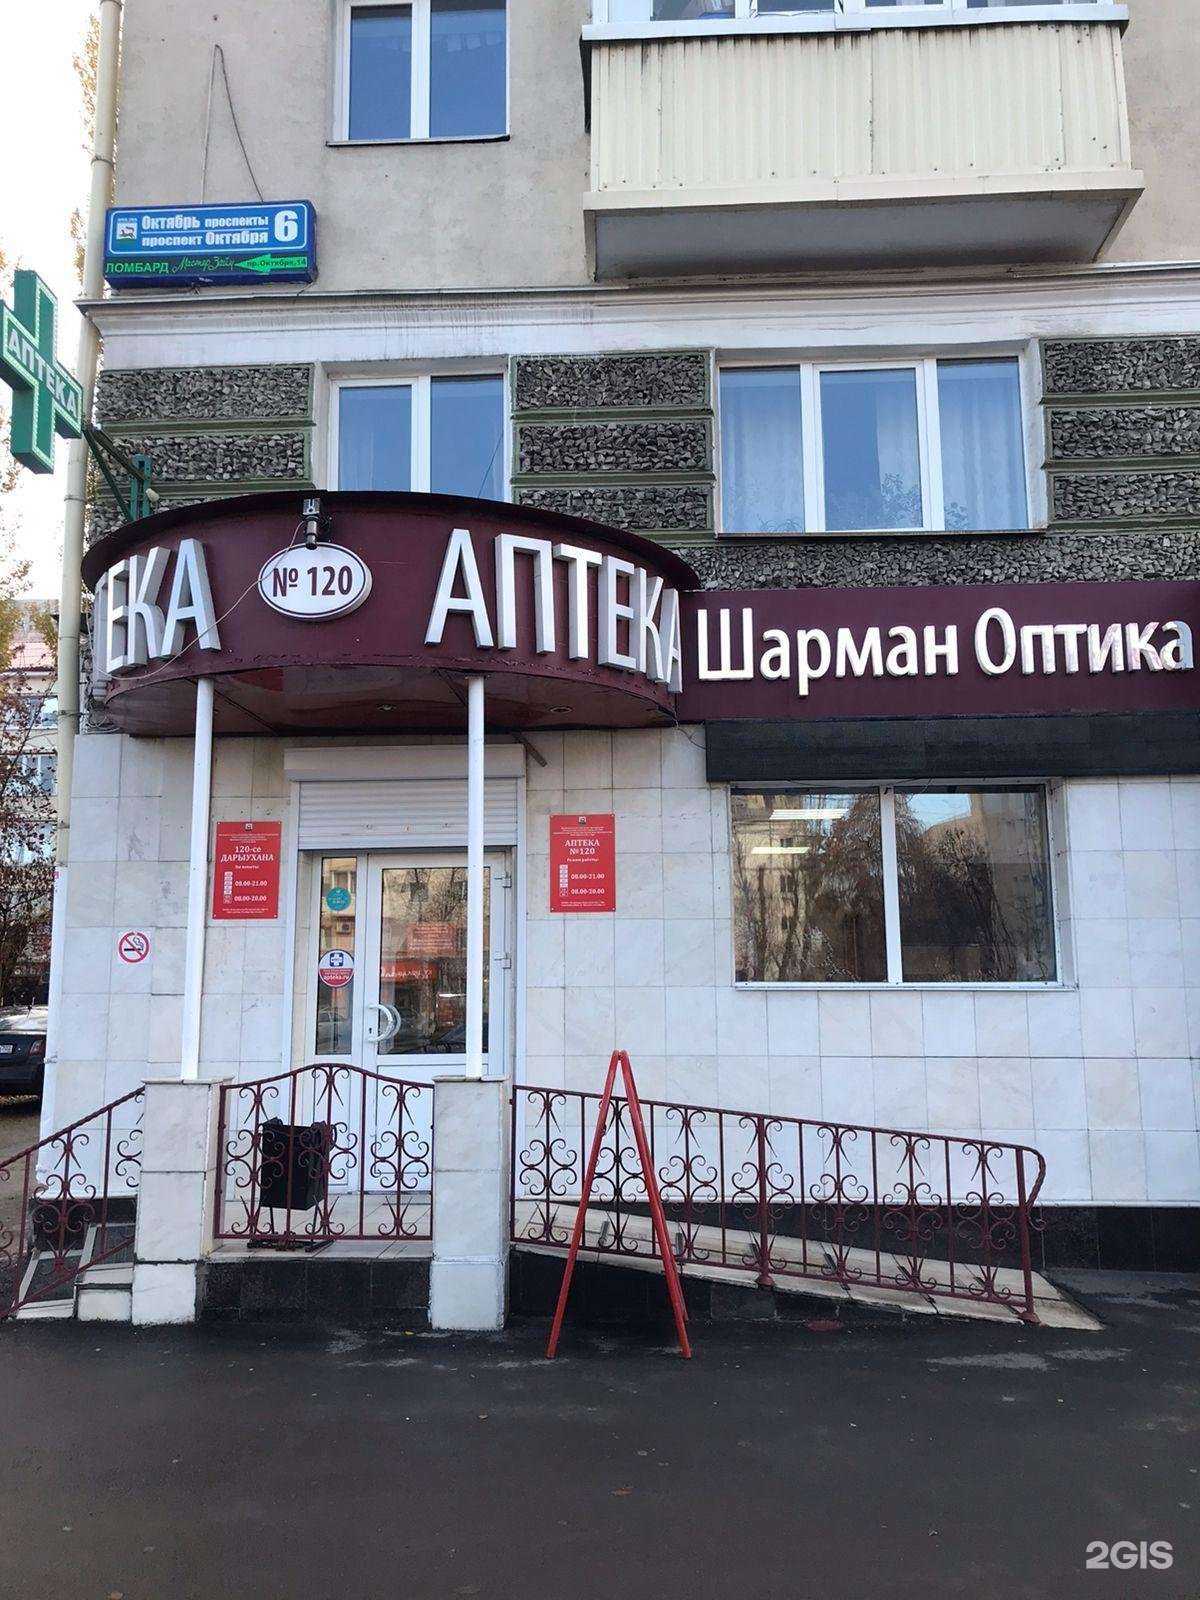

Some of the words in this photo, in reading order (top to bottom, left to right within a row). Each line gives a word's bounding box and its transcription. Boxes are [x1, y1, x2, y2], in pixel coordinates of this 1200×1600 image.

[141, 235, 203, 247] проспект
[205, 230, 269, 245] Октября
[142, 214, 201, 230] Октябрь
[204, 215, 269, 229] проспекты
[274, 209, 299, 243] 6
[105, 262, 170, 275] ЛОМБАРД
[8, 328, 78, 418] АПТЕКА
[307, 564, 353, 598] 120
[424, 528, 683, 693] АПТЕКА
[696, 607, 960, 697] Шарман
[974, 606, 1196, 677] Оптика
[564, 839, 601, 847] АПТЕКА
